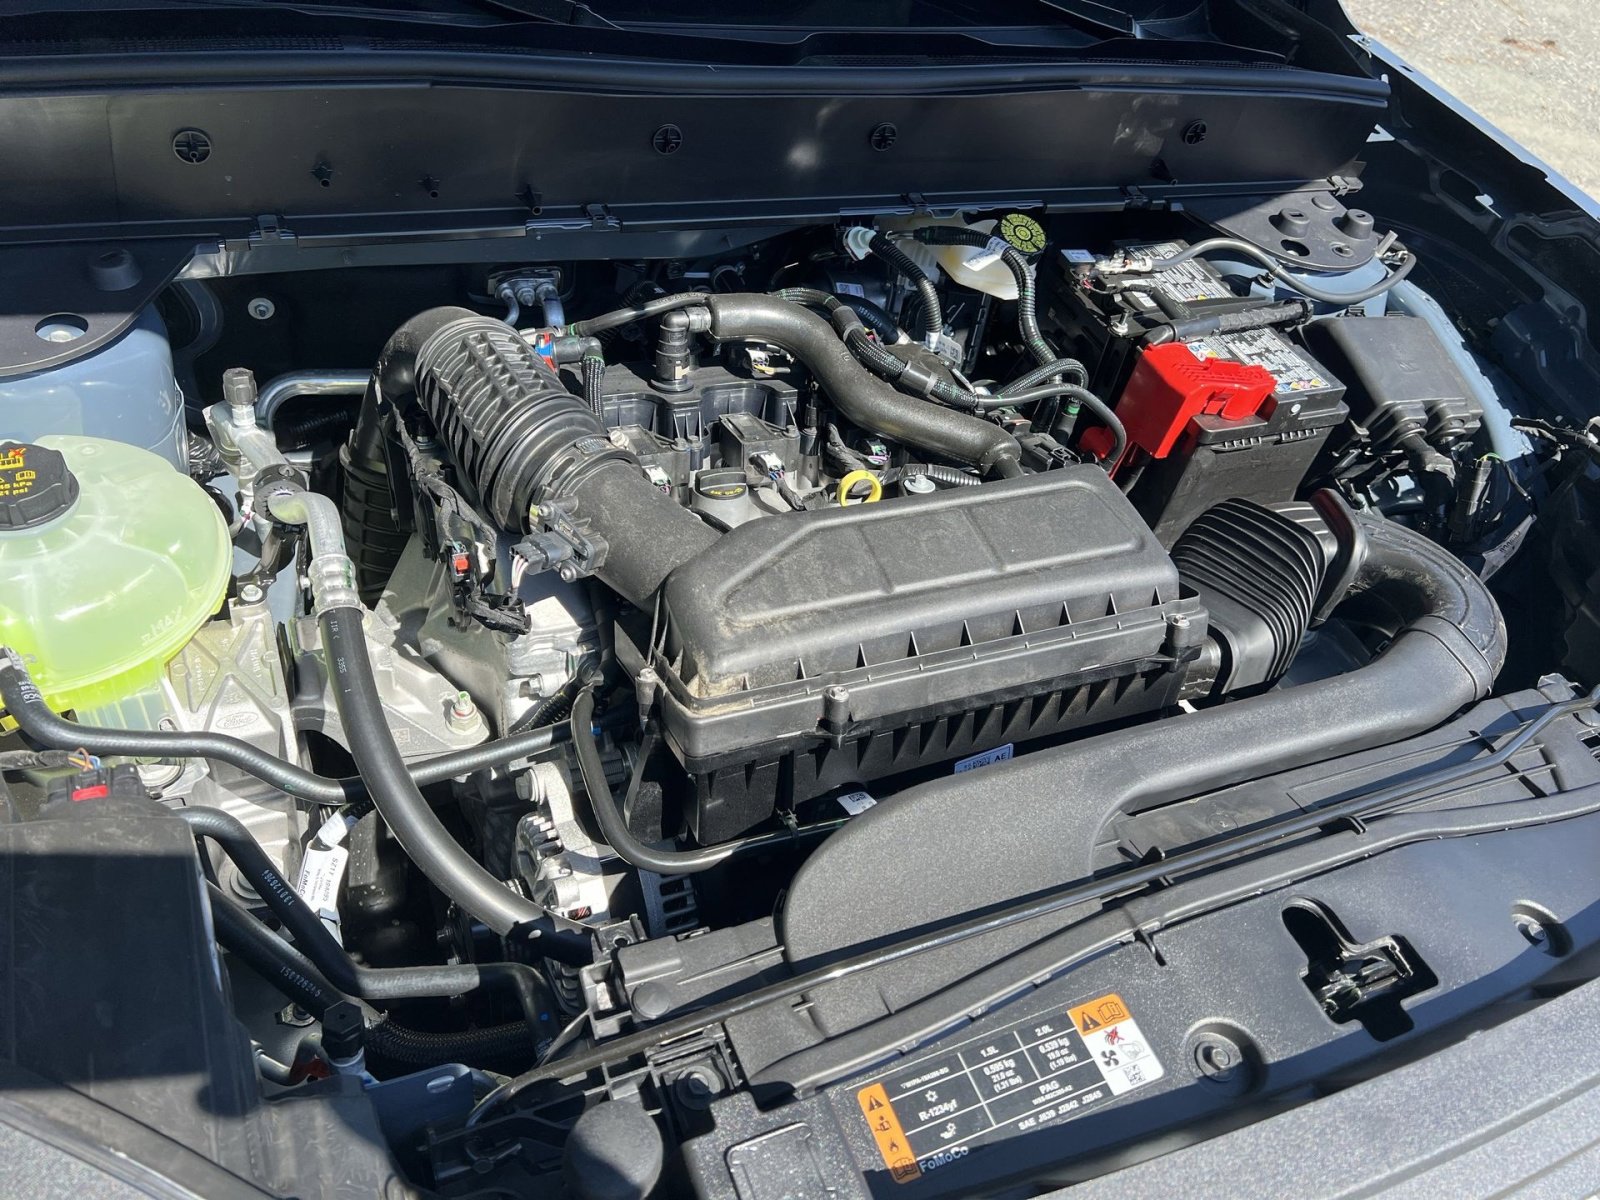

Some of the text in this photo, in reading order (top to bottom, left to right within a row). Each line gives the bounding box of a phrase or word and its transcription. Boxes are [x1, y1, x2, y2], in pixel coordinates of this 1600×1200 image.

[1035, 1024, 1053, 1036] 2.0L
[1056, 1037, 1070, 1051] kg
[980, 1046, 999, 1058] 1.5L
[1001, 1057, 1016, 1072] kg
[1038, 1080, 1060, 1095] PAG
[918, 1099, 958, 1121] R-1234yf
[1018, 1116, 1037, 1130] SAE
[919, 1143, 969, 1173] FoMoCo
